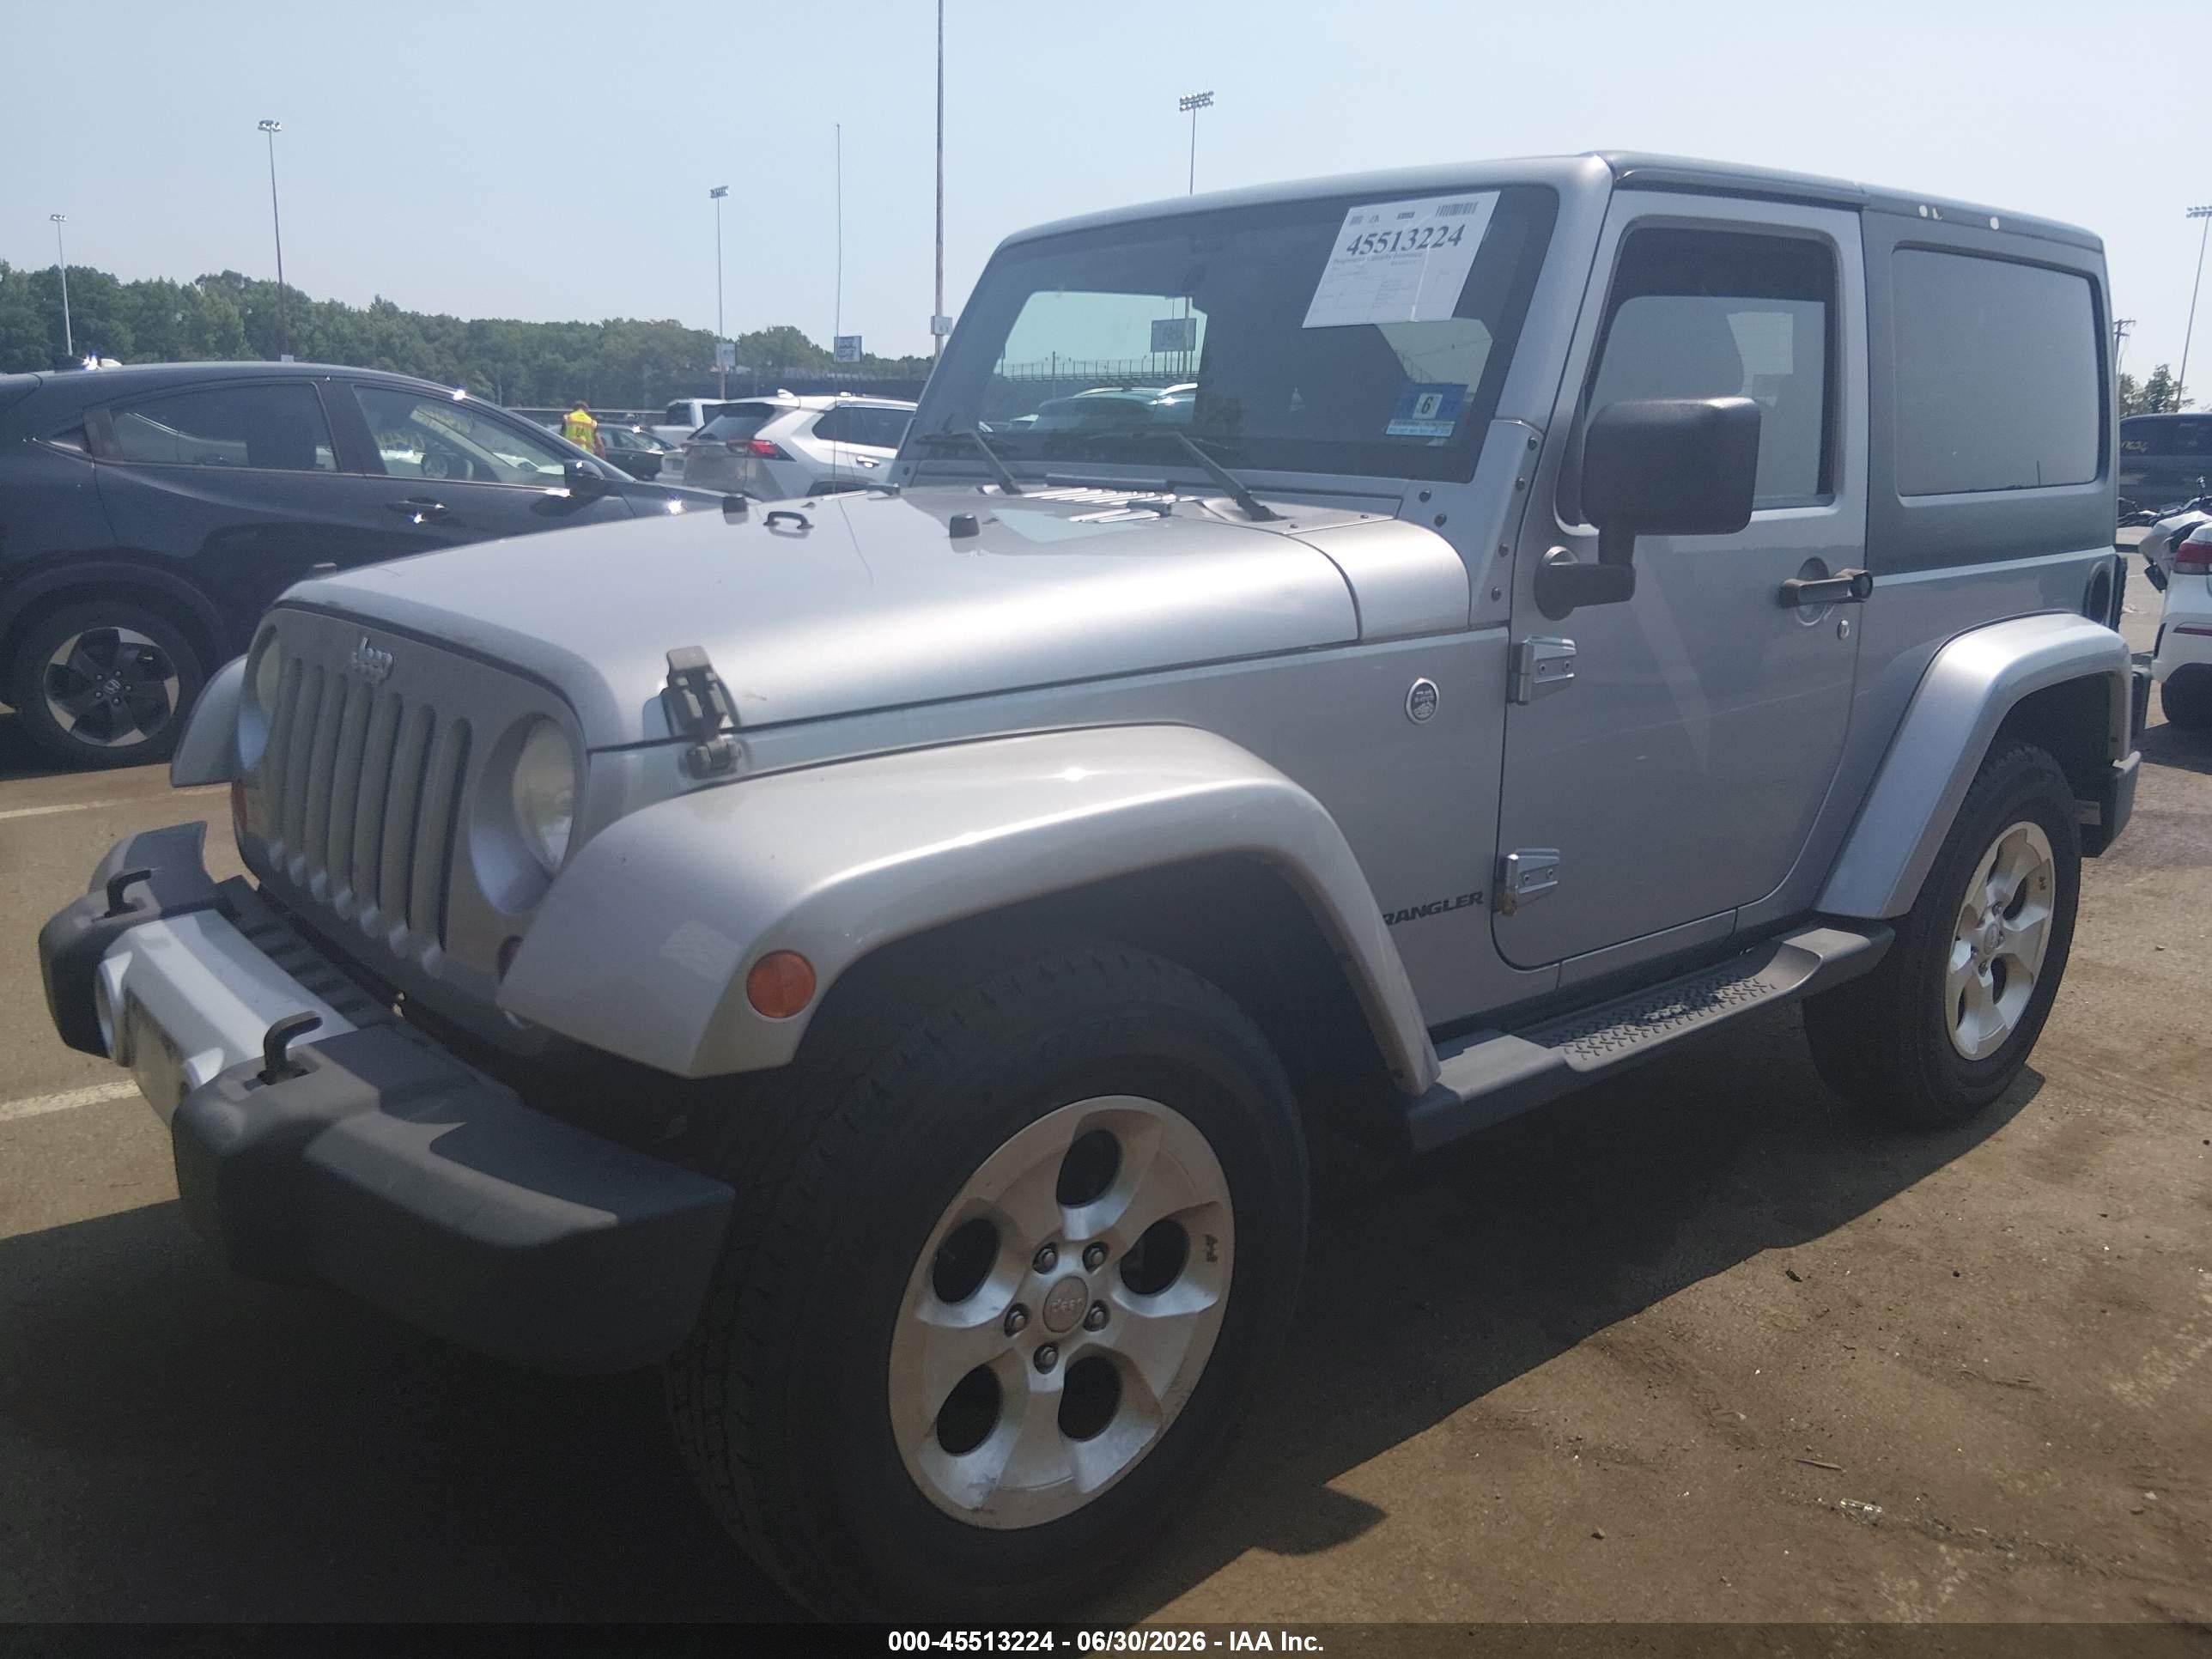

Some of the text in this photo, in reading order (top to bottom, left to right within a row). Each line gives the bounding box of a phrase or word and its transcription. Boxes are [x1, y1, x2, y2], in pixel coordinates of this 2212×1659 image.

[1346, 224, 1466, 256] 45513224
[1421, 396, 1434, 414] 6
[1382, 890, 1484, 926] RANGLER
